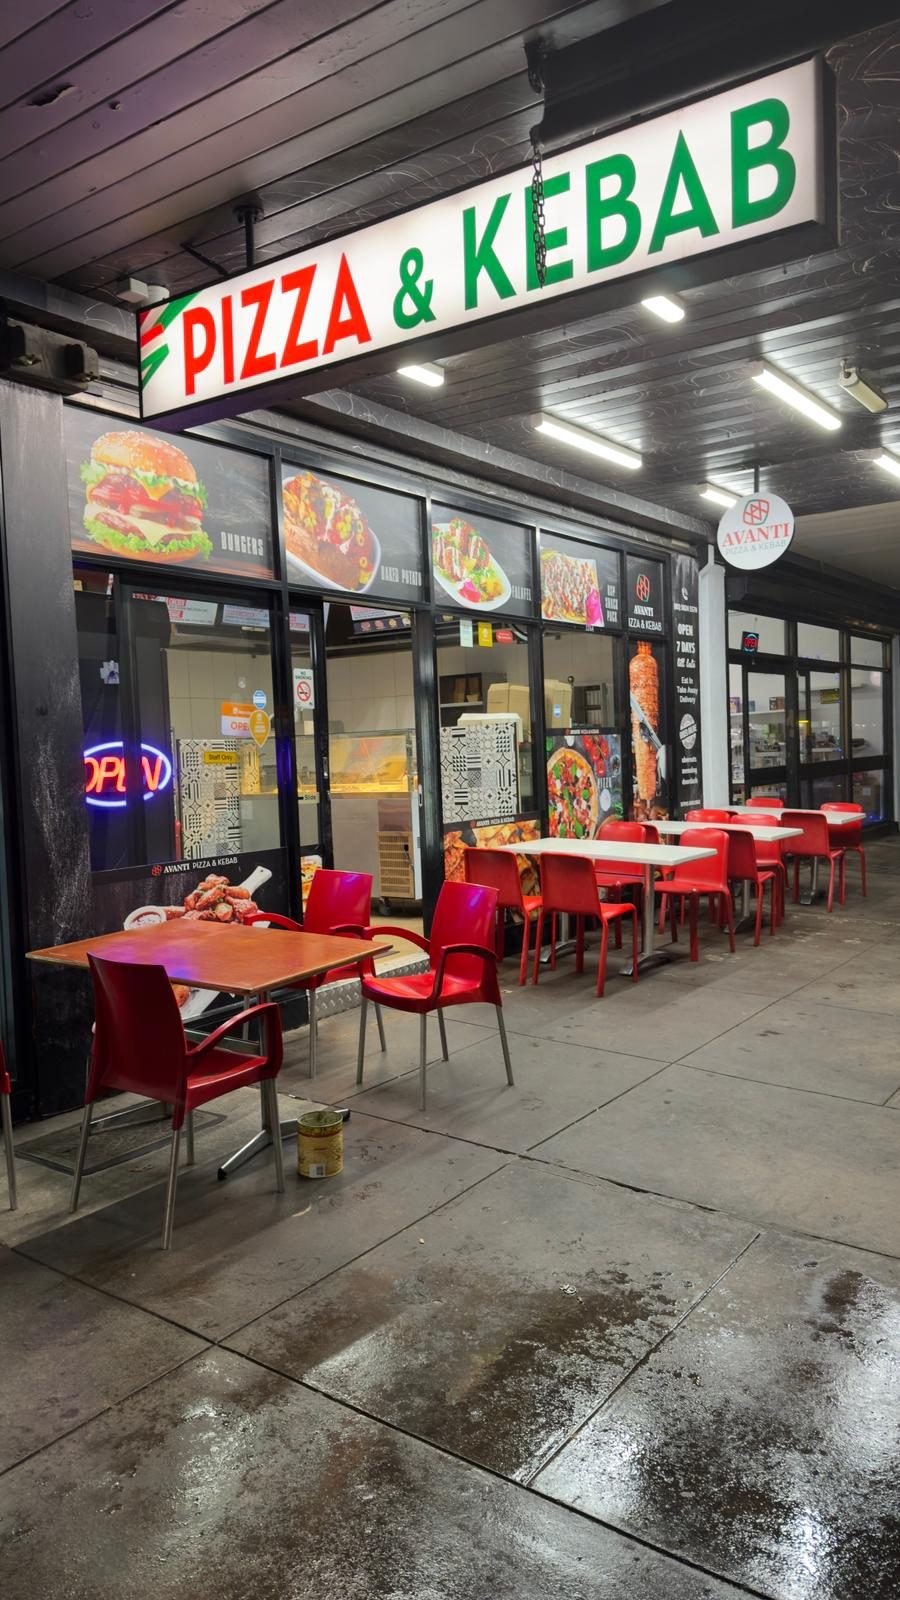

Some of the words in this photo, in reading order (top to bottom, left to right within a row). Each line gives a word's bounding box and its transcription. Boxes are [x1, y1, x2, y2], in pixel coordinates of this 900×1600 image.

[183, 252, 372, 397] PIZZA
[392, 247, 434, 329] &
[464, 97, 797, 310] KEBAB
[721, 522, 791, 547] AVANTI
[220, 531, 264, 557] BURGERS
[725, 545, 749, 556] PIZZA
[759, 539, 786, 550] KEBAB
[401, 568, 422, 587] POTATO
[605, 597, 618, 610] SNACK
[607, 610, 617, 623] PACK
[633, 605, 654, 617] AVANTI
[628, 617, 641, 629] IZZA
[641, 619, 645, 629] &
[645, 620, 662, 631] KEBAB
[677, 623, 693, 636] OPEN
[676, 641, 680, 652] 7
[681, 641, 696, 654] DAYS
[743, 637, 758, 648] OPEN
[676, 685, 687, 694] Take
[687, 686, 698, 696] Away
[221, 754, 232, 762] Only
[163, 863, 190, 874] AVANTI
[192, 860, 211, 870] PIZZA
[211, 859, 217, 867] &
[217, 856, 238, 866] KEBAB
